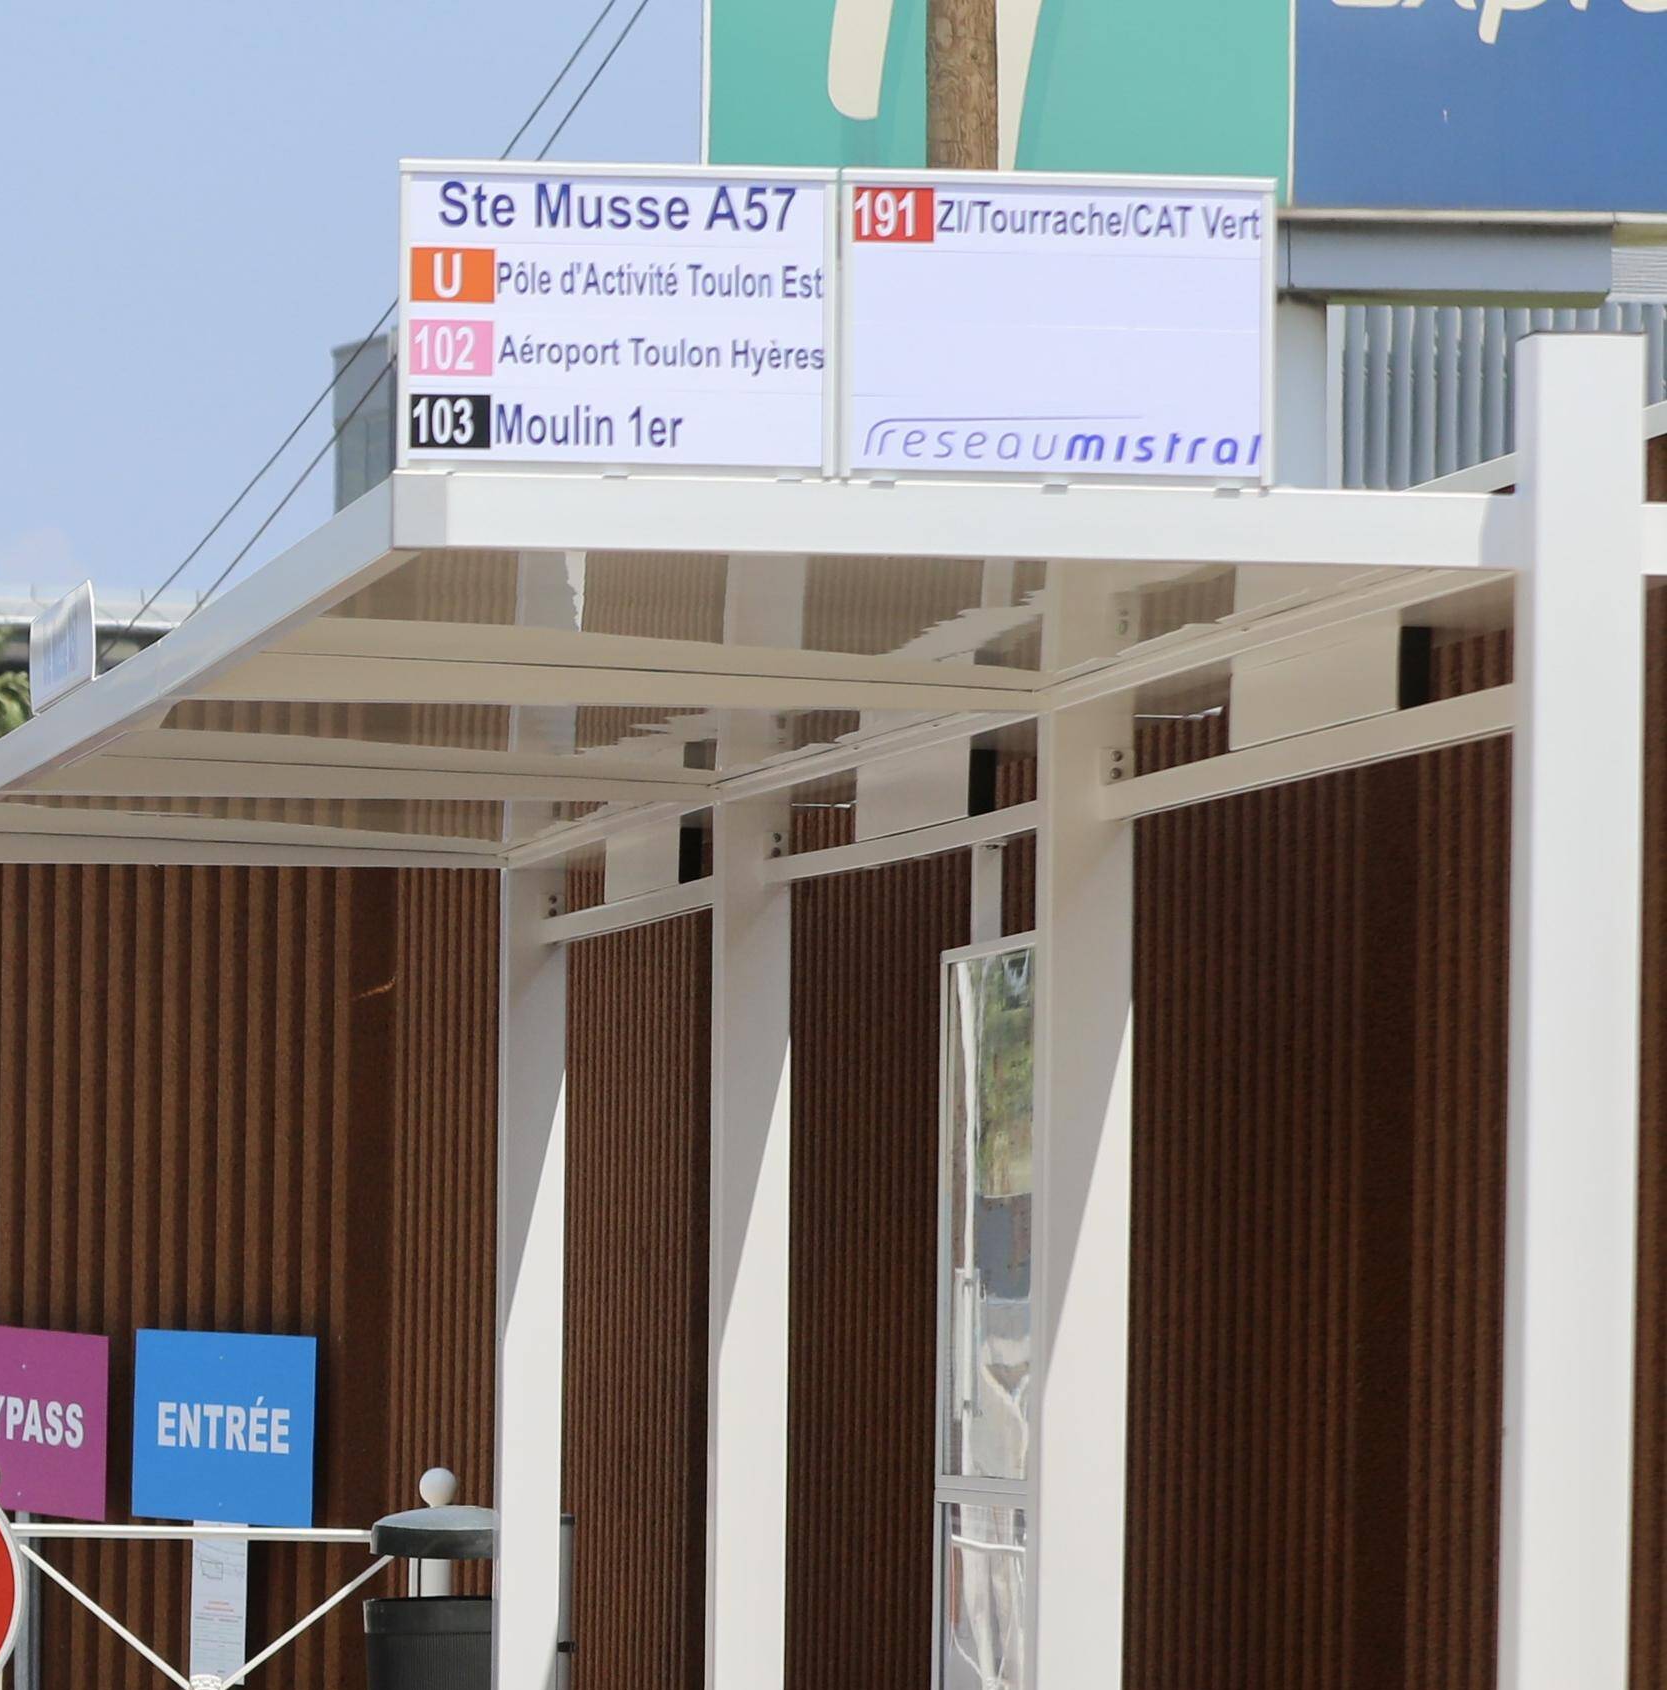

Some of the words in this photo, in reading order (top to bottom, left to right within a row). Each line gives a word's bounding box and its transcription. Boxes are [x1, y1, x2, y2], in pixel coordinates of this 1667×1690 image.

[438, 181, 515, 228] Ste
[534, 182, 690, 230] Musse
[704, 186, 797, 233] A57
[854, 190, 915, 238] 191
[936, 200, 1192, 239] ZI/Tourrache/CAT
[1204, 203, 1260, 240] Vert
[432, 251, 463, 299] U
[496, 261, 551, 296] Pôle
[561, 261, 678, 297] d'Activité
[686, 264, 772, 299] Toulon
[781, 265, 825, 300] Est
[413, 325, 476, 372] 102
[498, 335, 619, 372] Aéroport
[631, 338, 721, 369] Toulon
[731, 339, 825, 377] Hyères
[412, 398, 475, 445] 103
[495, 403, 614, 446] Moulin
[628, 405, 683, 448] 1er
[157, 1396, 291, 1454] ENTRÉE
